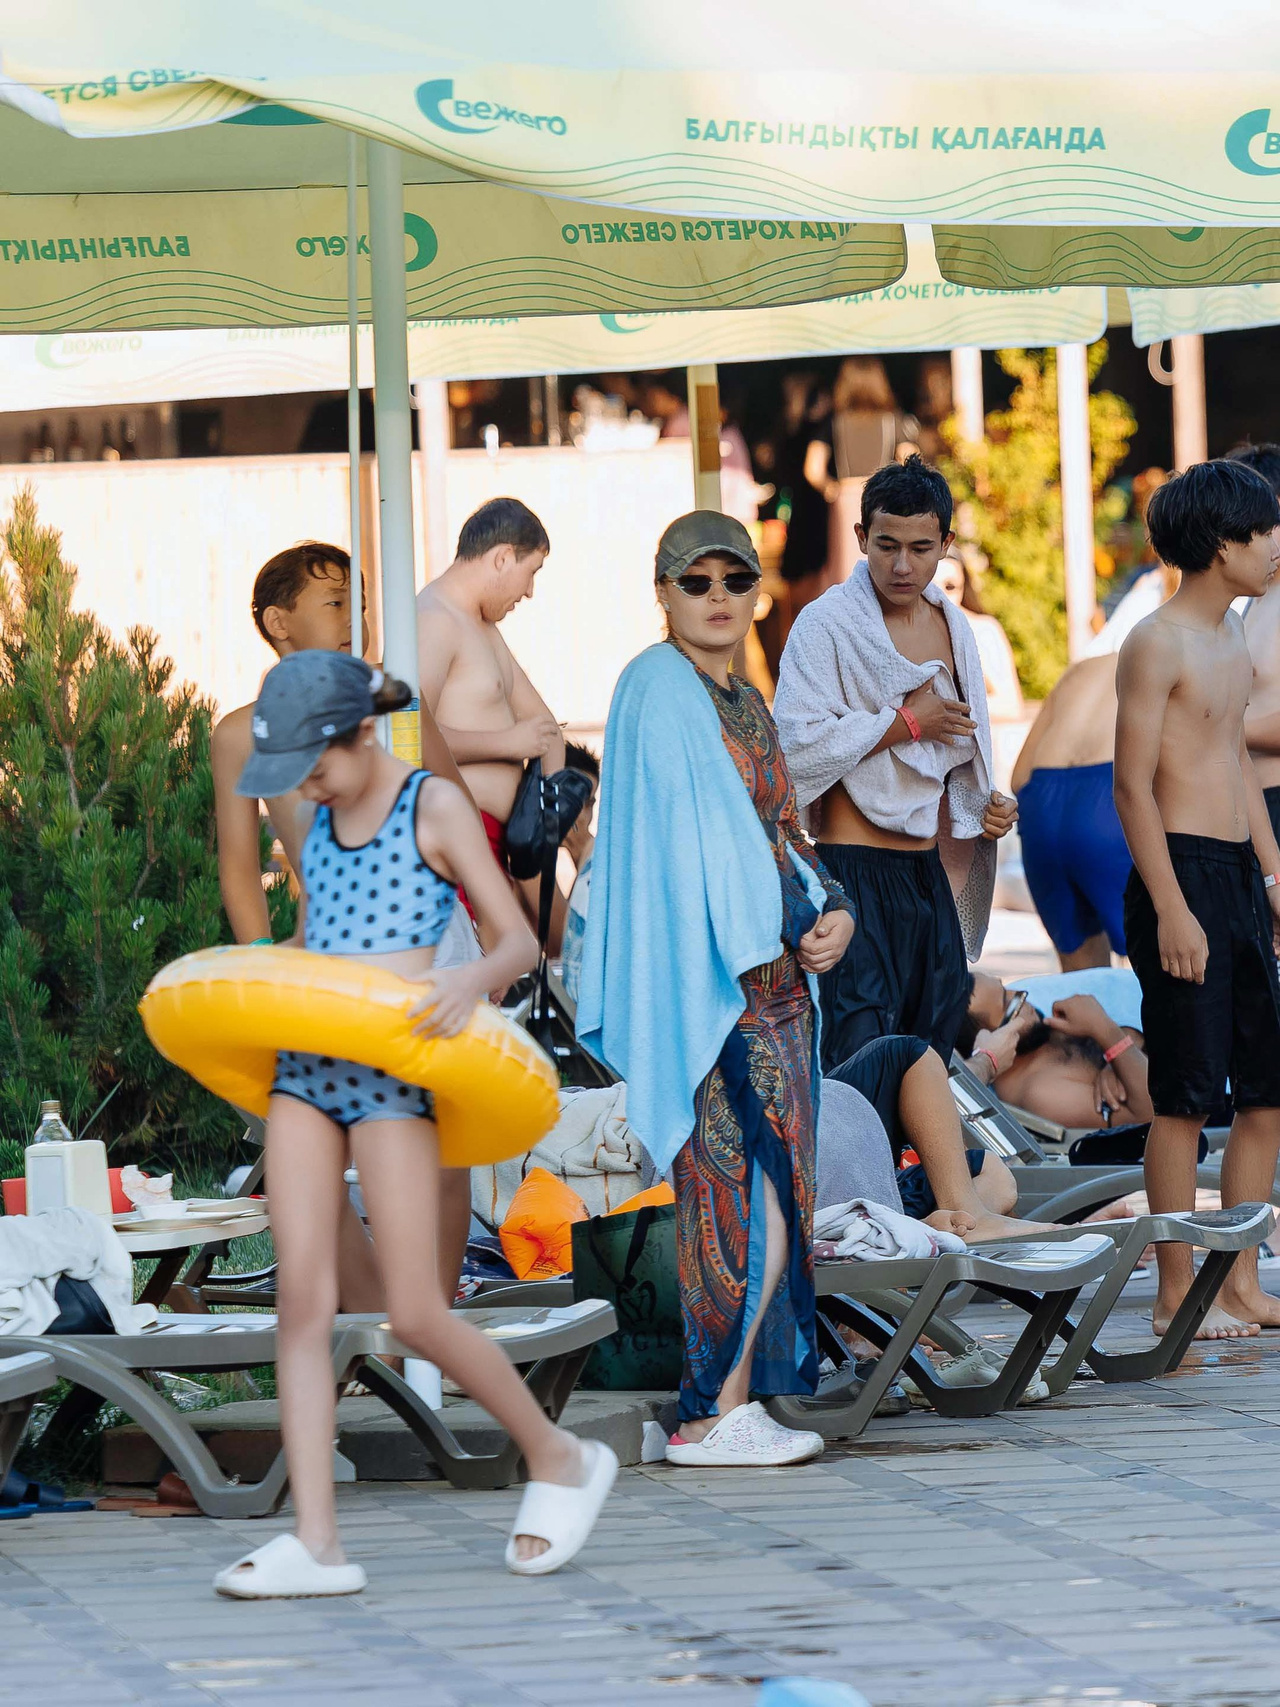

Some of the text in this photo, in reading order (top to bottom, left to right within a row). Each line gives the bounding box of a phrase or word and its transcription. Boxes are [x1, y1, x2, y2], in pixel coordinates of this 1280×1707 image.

[416, 78, 568, 136] Свежего
[686, 118, 1106, 154] БАЛҒЫНДЫҚТЫ ҚАЛАҒАНДА
